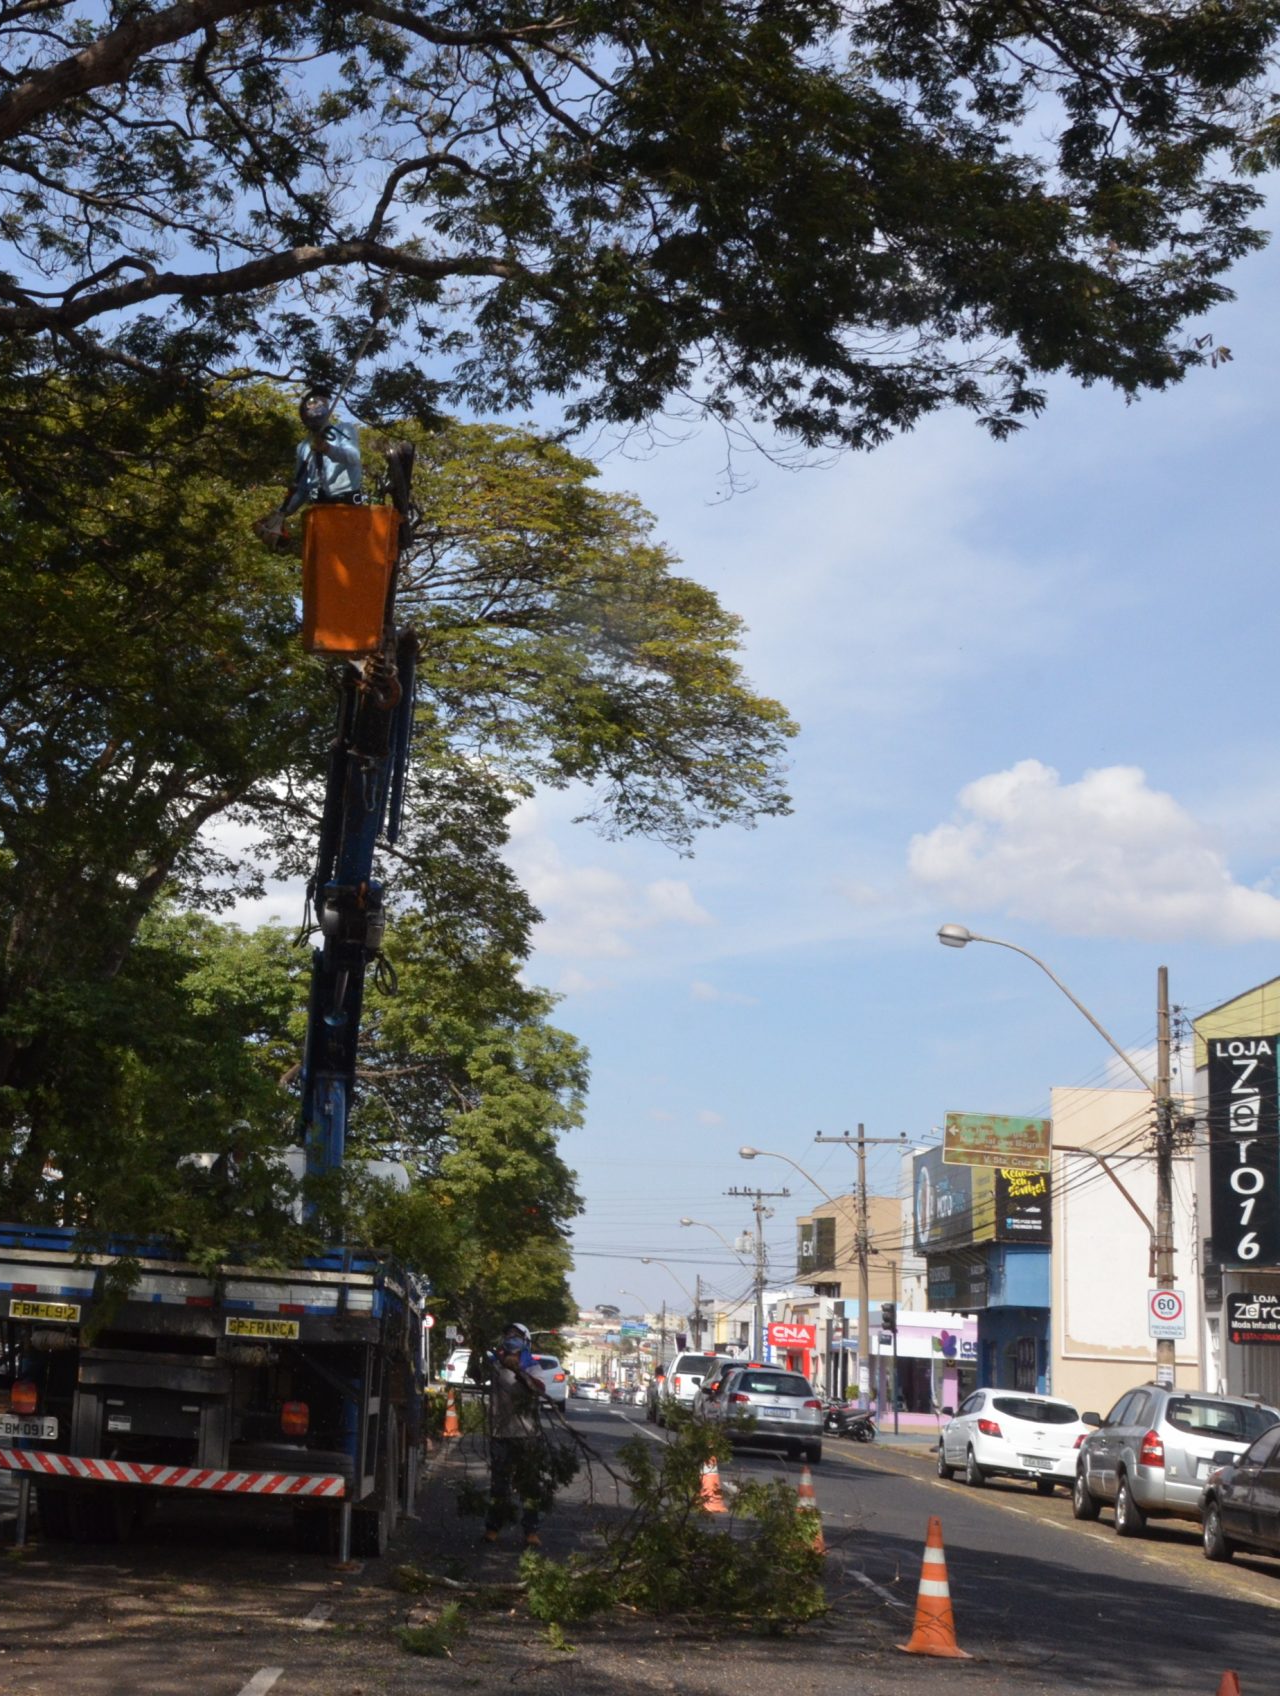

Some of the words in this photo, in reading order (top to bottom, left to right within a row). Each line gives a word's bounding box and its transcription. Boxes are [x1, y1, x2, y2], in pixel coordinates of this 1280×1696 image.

[1216, 1041, 1272, 1057] LOJA
[1158, 1299, 1175, 1310] 60
[1253, 1295, 1278, 1303] LOJA
[1232, 1320, 1251, 1329] Moda
[773, 1326, 811, 1340] CNA
